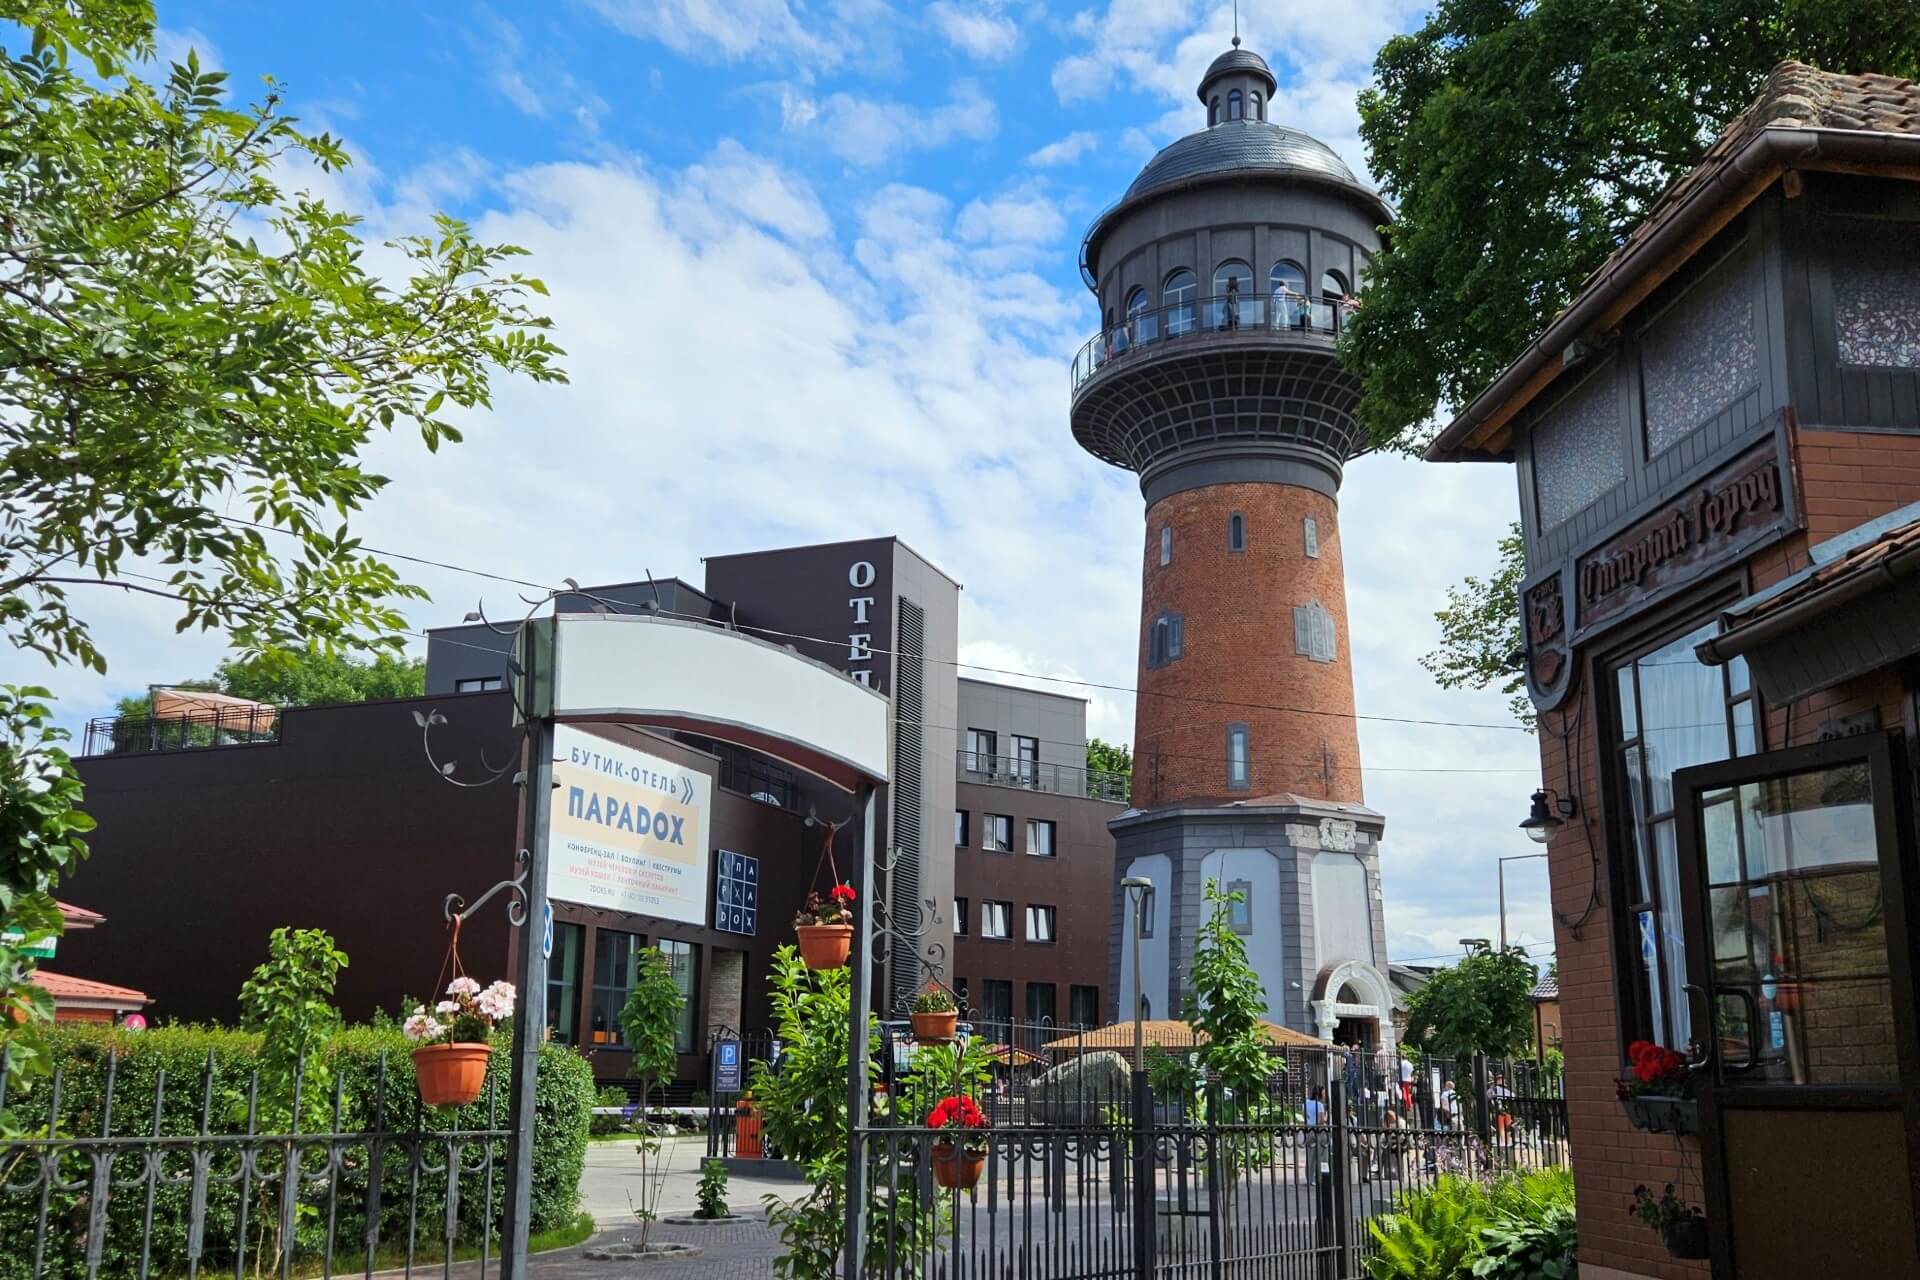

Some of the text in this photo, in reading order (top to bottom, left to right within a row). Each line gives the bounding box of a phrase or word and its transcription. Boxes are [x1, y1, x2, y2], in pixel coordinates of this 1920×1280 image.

[571, 747, 677, 794] БУТИК-ОТЕЛЬ
[567, 842, 615, 860] КОНФЕРЕНЦ-ЗАЛ
[725, 1047, 734, 1062] P
